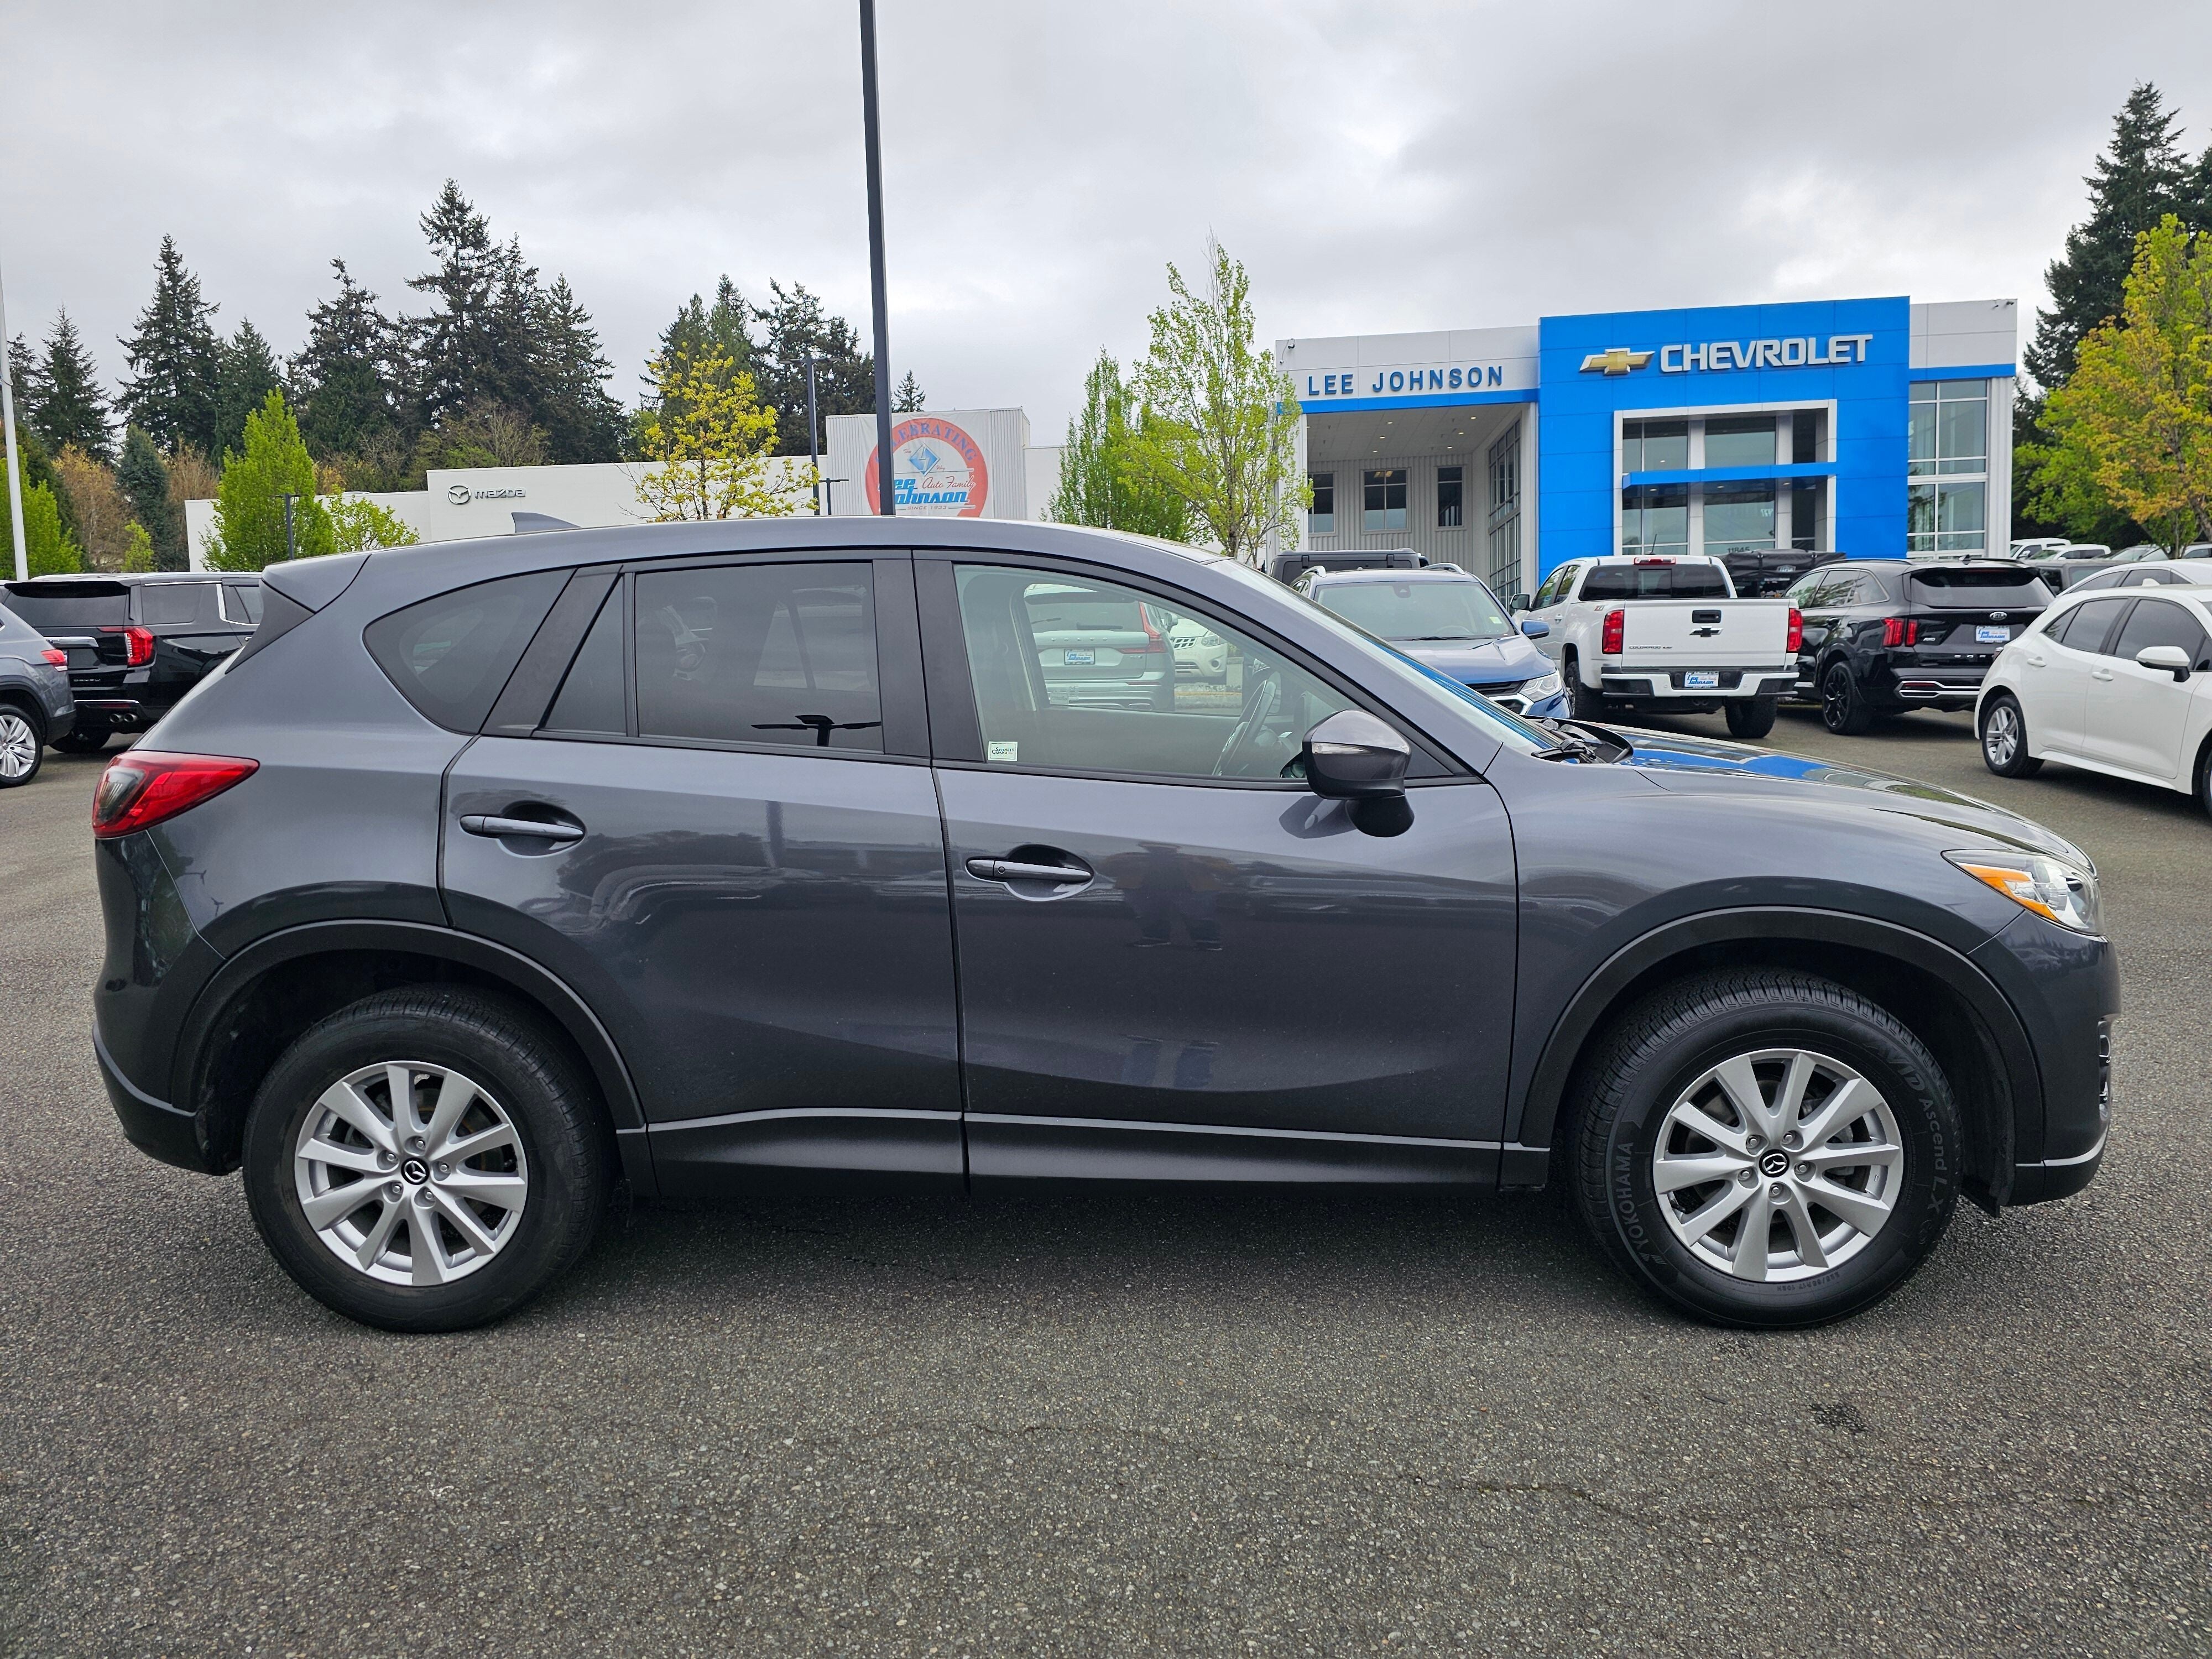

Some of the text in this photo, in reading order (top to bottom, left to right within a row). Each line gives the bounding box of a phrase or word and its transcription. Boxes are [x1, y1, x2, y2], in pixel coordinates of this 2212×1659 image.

[1661, 334, 1873, 372] CHEVROLET
[1308, 366, 1502, 396] LEE JOHNSON
[474, 488, 526, 498] mazda
[894, 474, 975, 492] ee Auto Family
[894, 486, 969, 505] ohnson
[1918, 1099, 1947, 1171] Ascend
[1615, 1142, 1649, 1250] YOKOHAMA
[1927, 1176, 1947, 1214] LX
